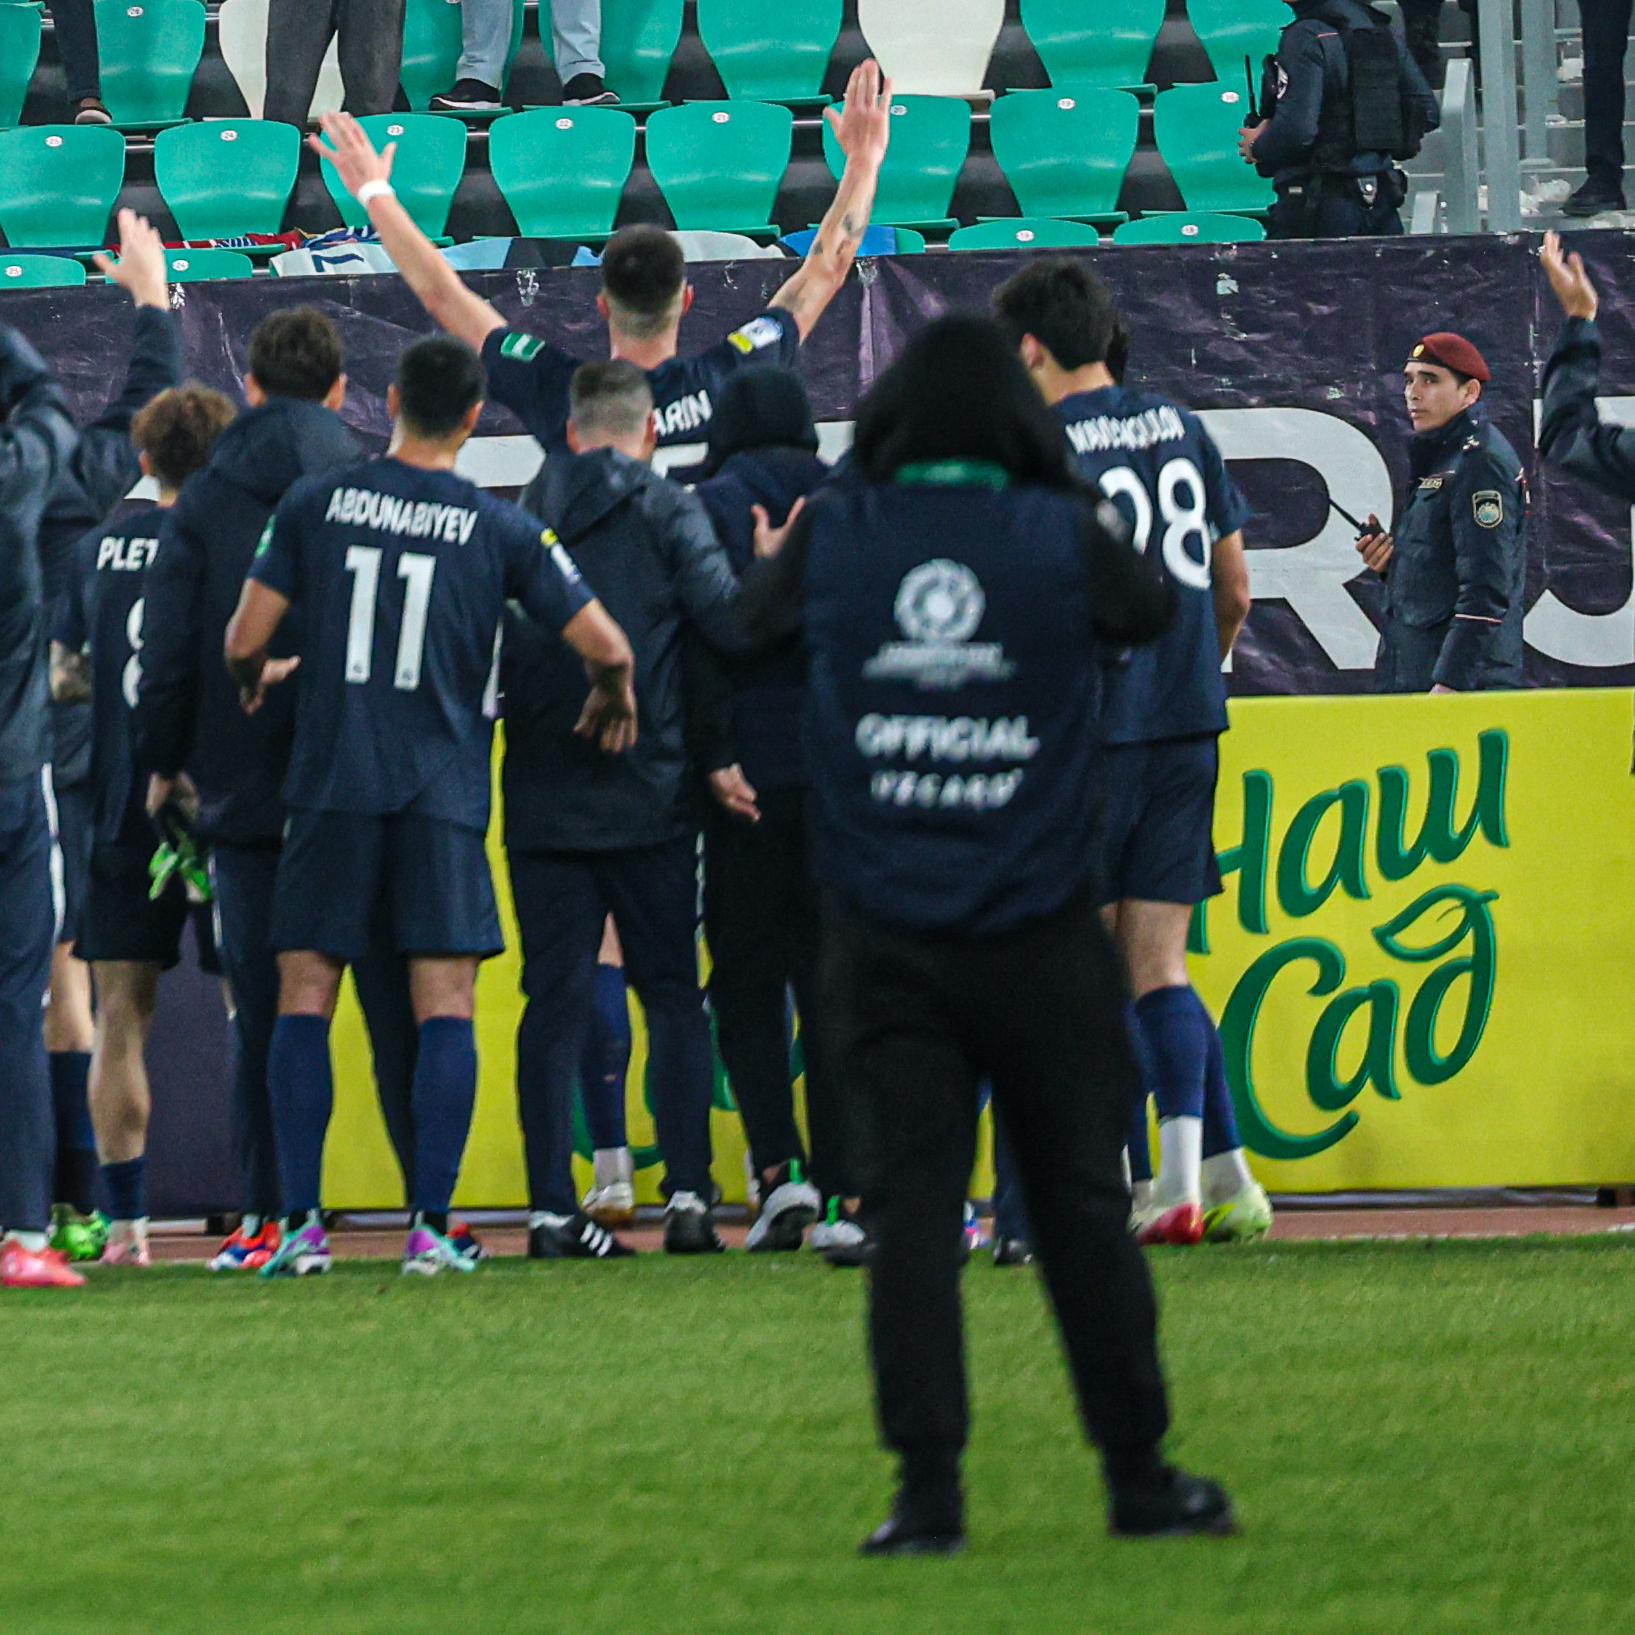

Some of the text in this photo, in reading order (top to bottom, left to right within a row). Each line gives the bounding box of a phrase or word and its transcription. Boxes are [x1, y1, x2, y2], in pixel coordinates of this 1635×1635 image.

[1098, 457, 1211, 590] 28
[344, 544, 437, 691] 11
[855, 712, 1041, 763] OFFICIAL
[1186, 728, 1510, 954] Наш
[1218, 883, 1499, 1161] Сад
